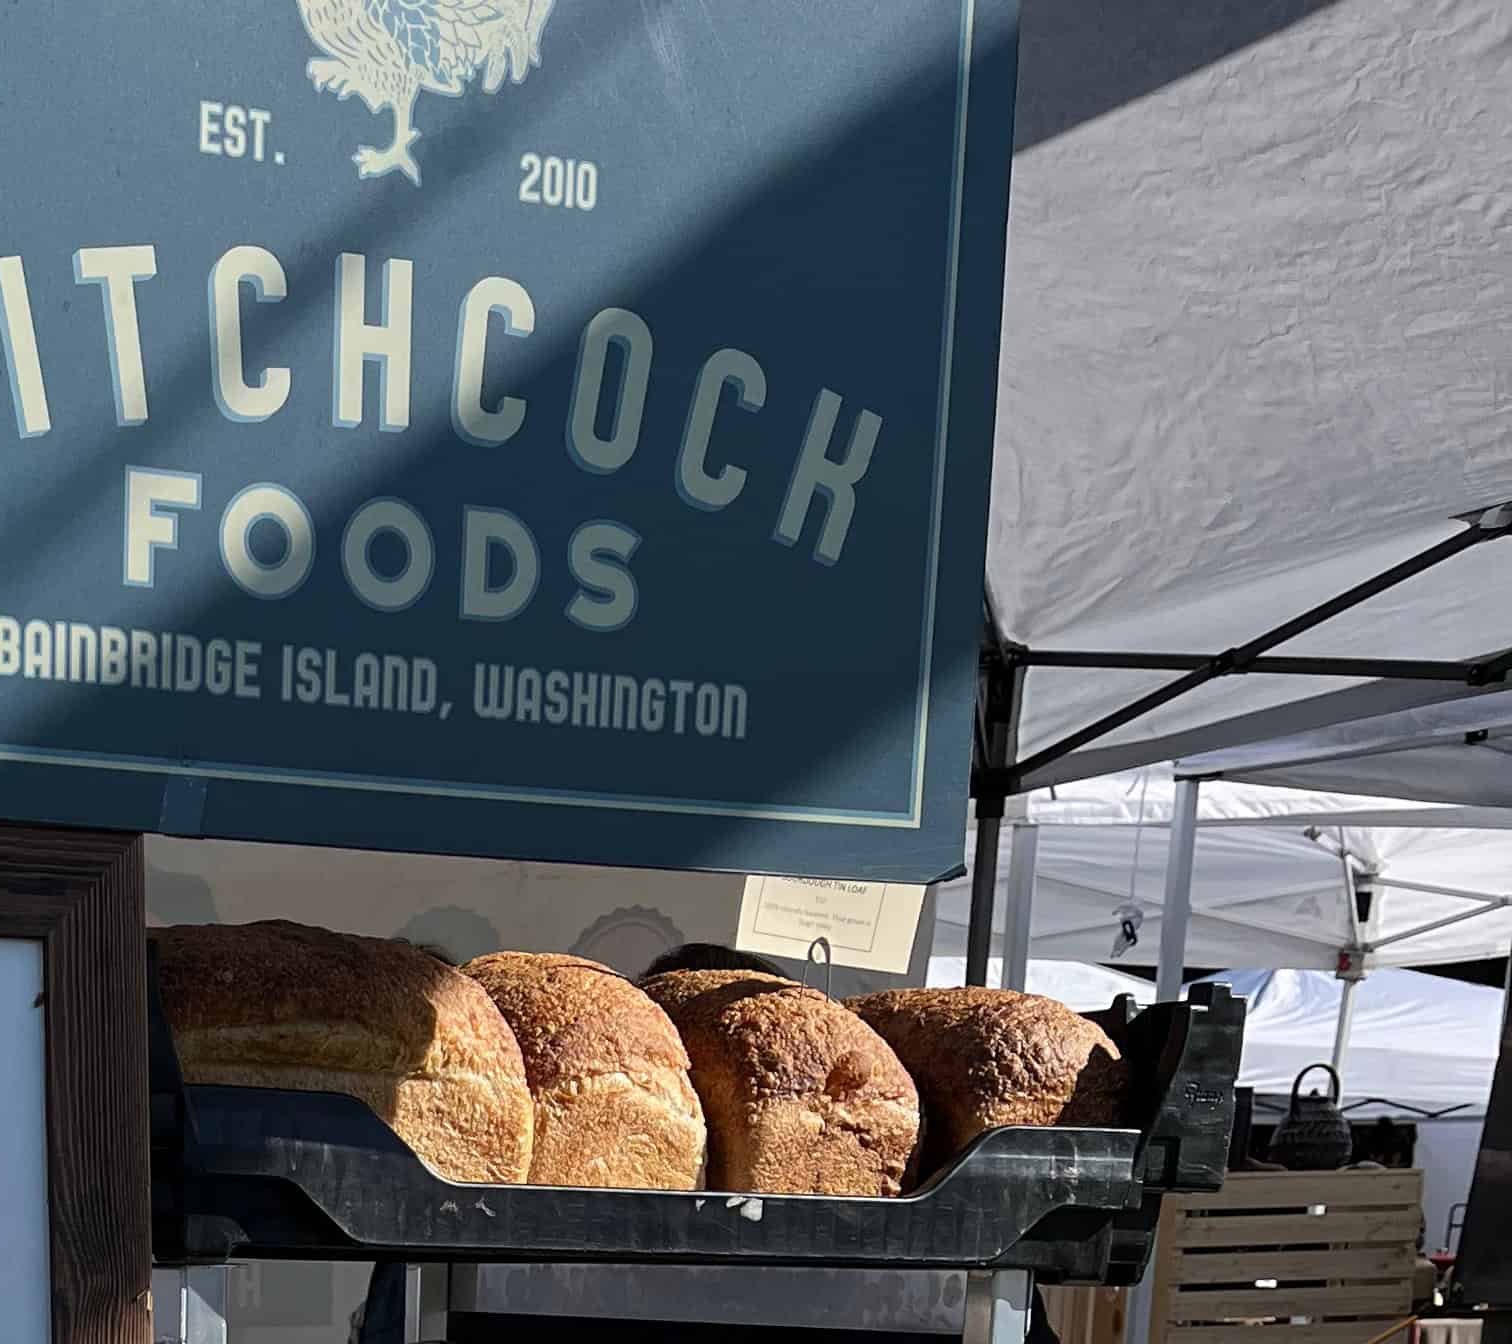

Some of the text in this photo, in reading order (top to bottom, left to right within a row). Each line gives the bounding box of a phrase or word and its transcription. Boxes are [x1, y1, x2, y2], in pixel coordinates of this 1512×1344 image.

[199, 101, 285, 165] EST.
[519, 153, 598, 211] 2010
[124, 465, 642, 632] FOODS
[281, 647, 451, 721] ISLAND,
[474, 664, 748, 739] WASHINGTON
